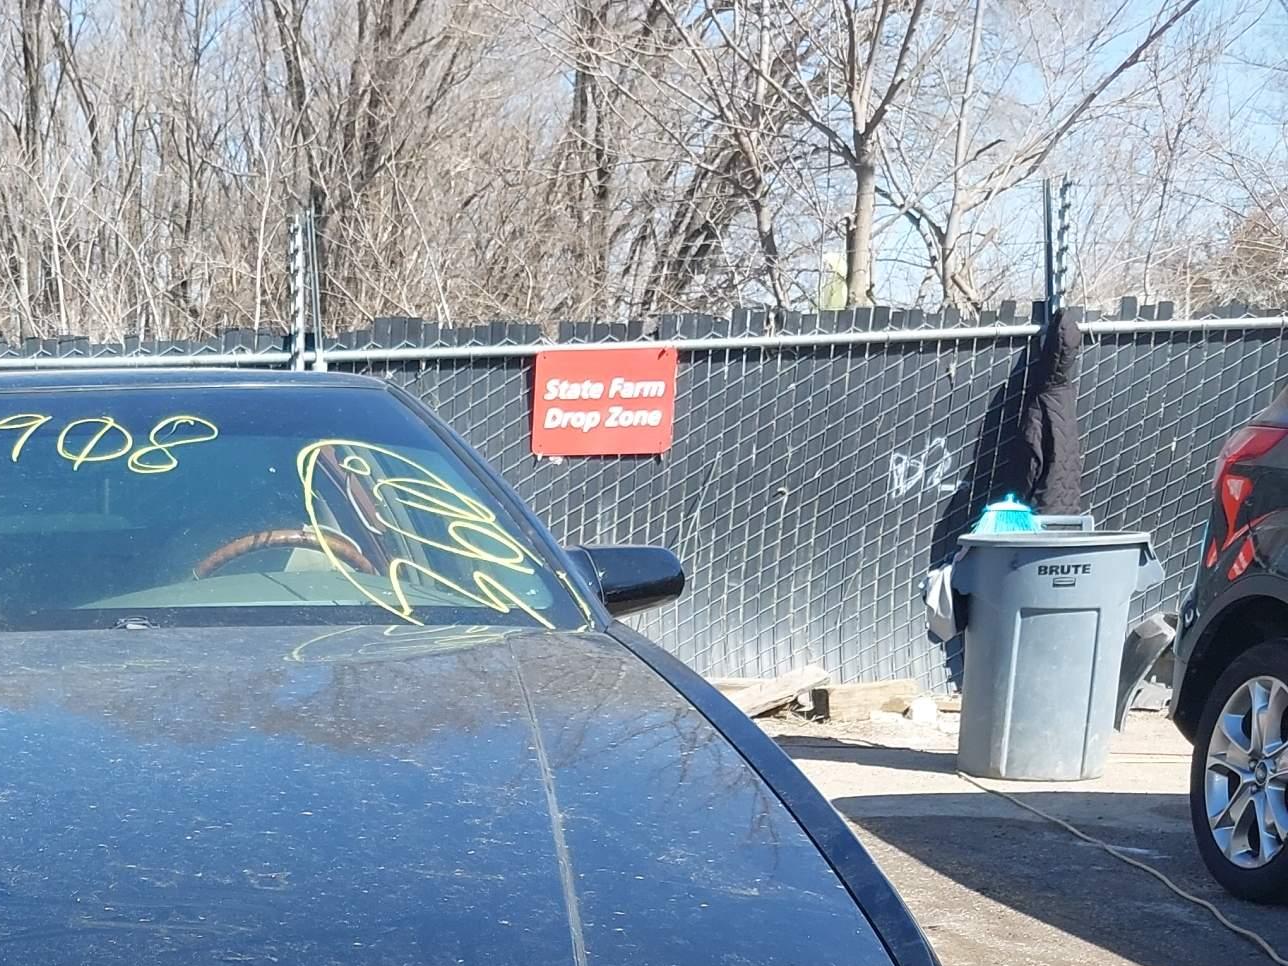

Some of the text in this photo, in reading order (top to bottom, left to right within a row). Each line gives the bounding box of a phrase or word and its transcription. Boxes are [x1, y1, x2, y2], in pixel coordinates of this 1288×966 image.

[543, 377, 665, 400] State Farm
[543, 406, 662, 432] Drop Zone
[1037, 564, 1091, 576] BRUTE
